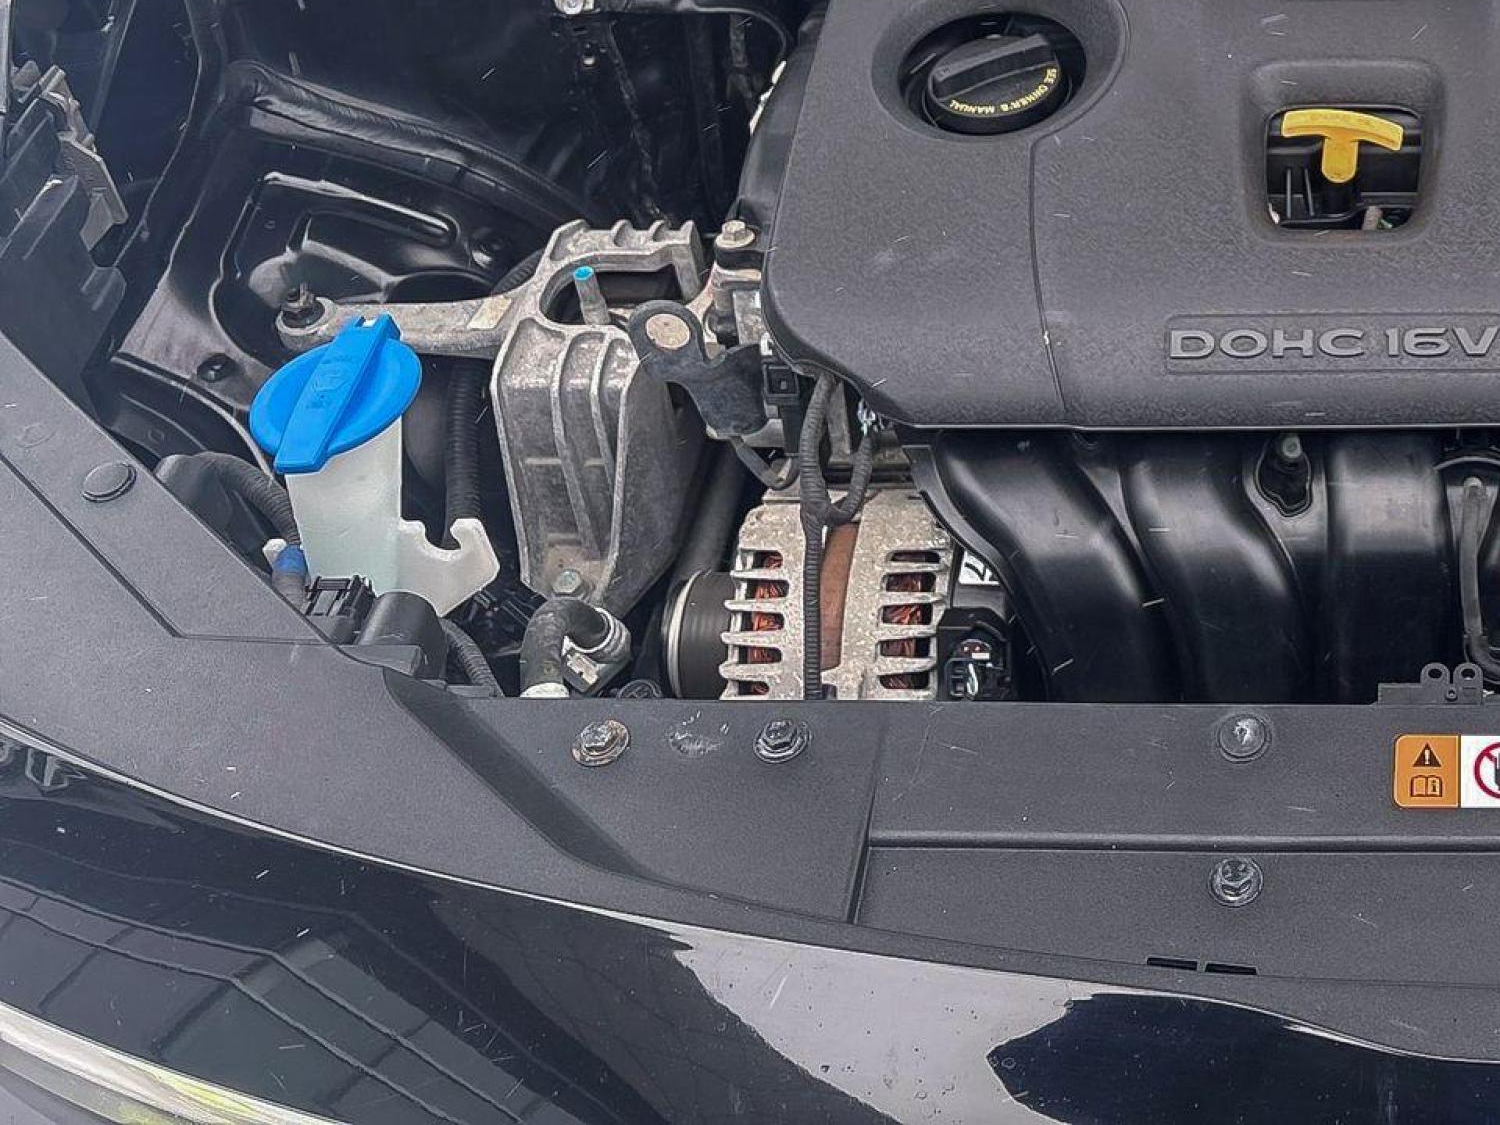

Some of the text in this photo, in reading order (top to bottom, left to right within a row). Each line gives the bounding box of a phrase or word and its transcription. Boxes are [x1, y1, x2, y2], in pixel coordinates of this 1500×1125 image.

[949, 99, 996, 115] MANUAL
[1169, 325, 1500, 359] DOHC 16V
